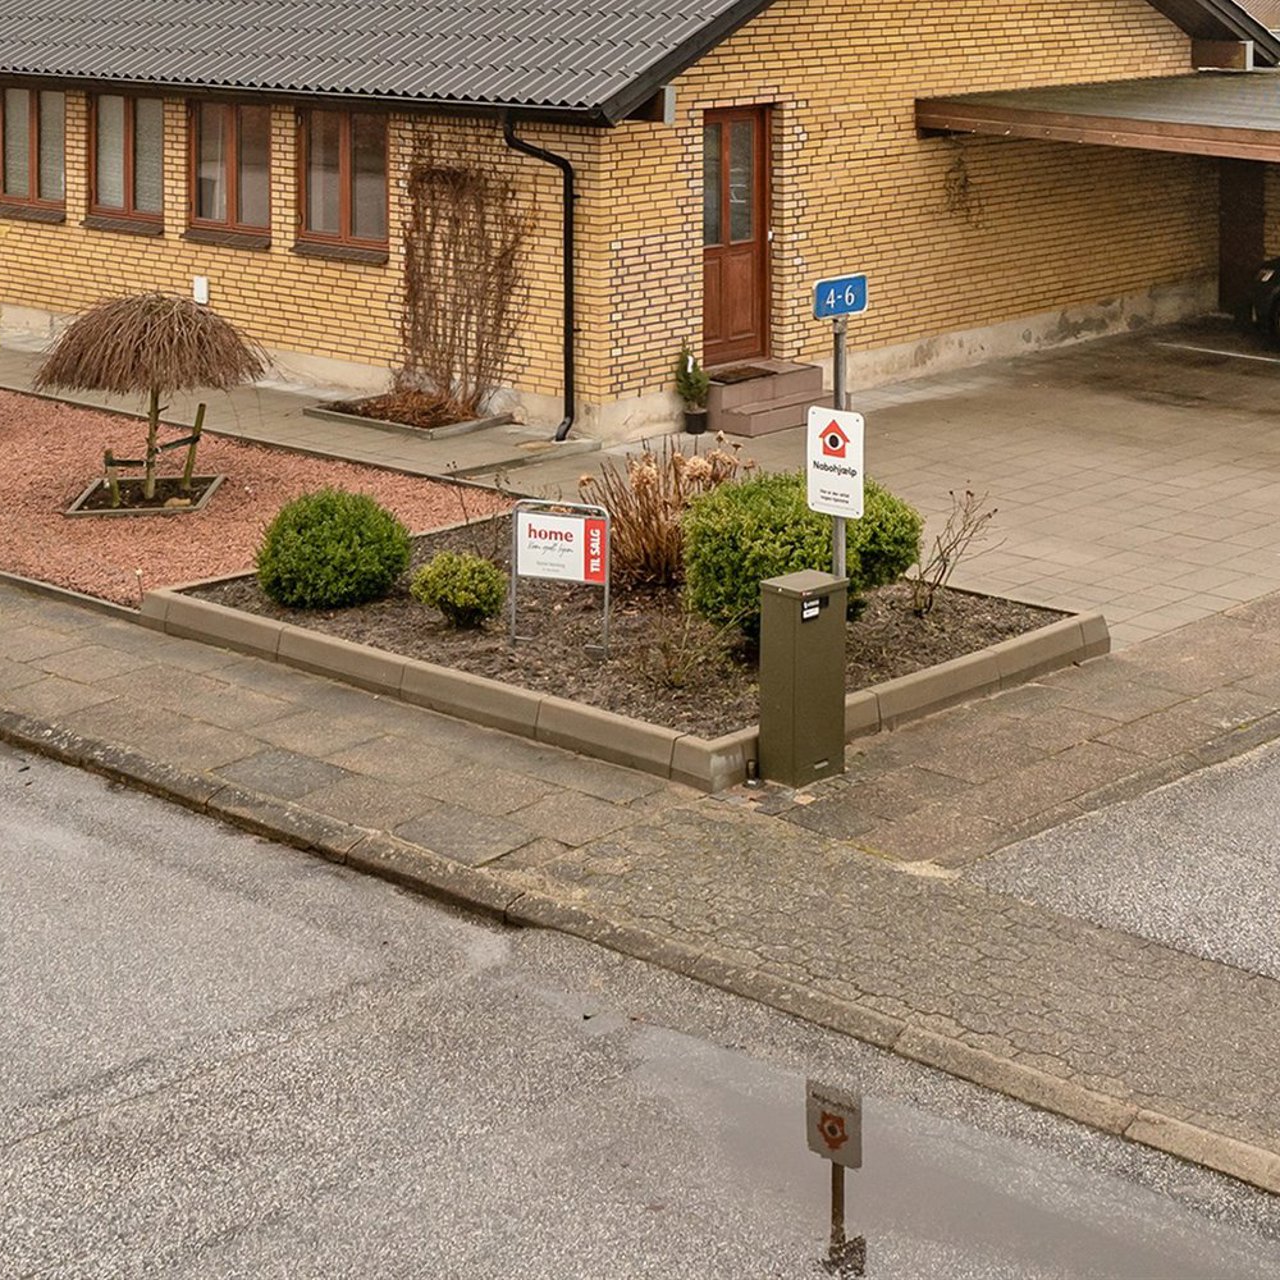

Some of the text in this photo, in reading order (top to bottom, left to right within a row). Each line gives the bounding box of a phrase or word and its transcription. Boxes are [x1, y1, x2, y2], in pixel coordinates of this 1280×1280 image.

[826, 284, 855, 309] 4-6
[528, 523, 574, 542] home
[590, 528, 601, 573] TIL SALG
